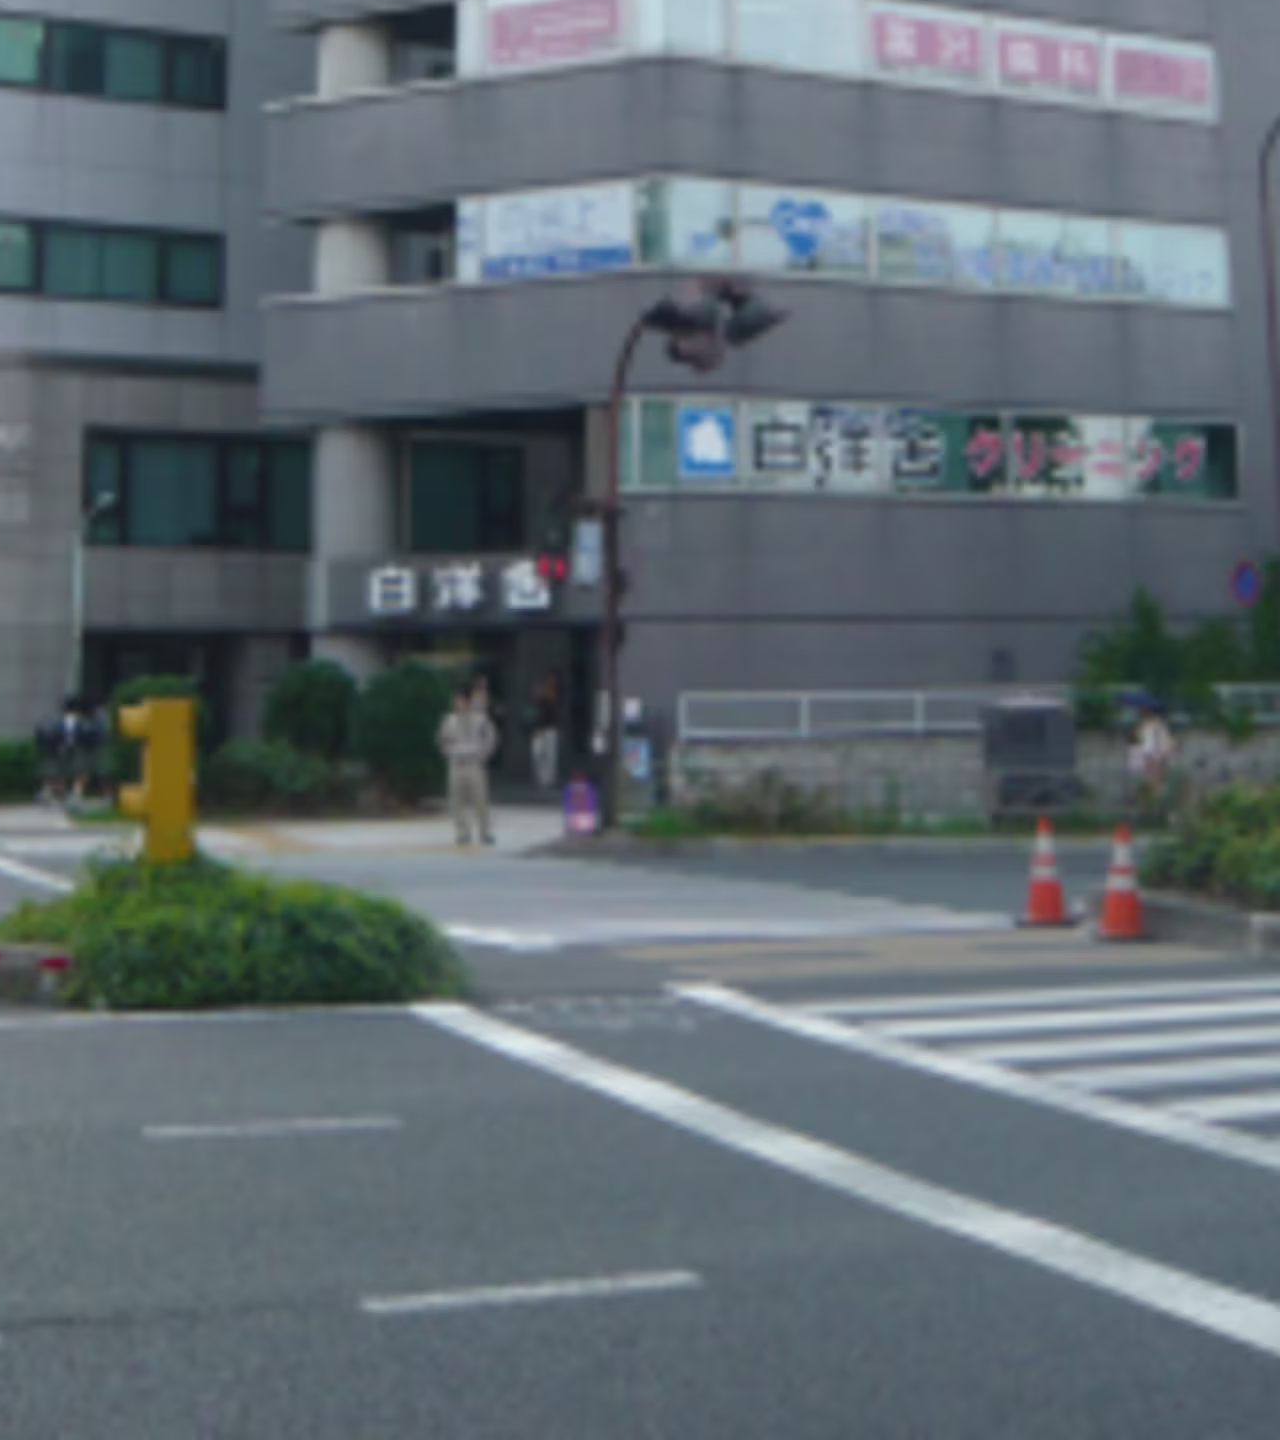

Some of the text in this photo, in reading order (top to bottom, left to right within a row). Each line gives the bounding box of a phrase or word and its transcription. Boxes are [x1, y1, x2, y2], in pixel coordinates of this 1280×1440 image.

[965, 425, 1208, 482] クリーニング
